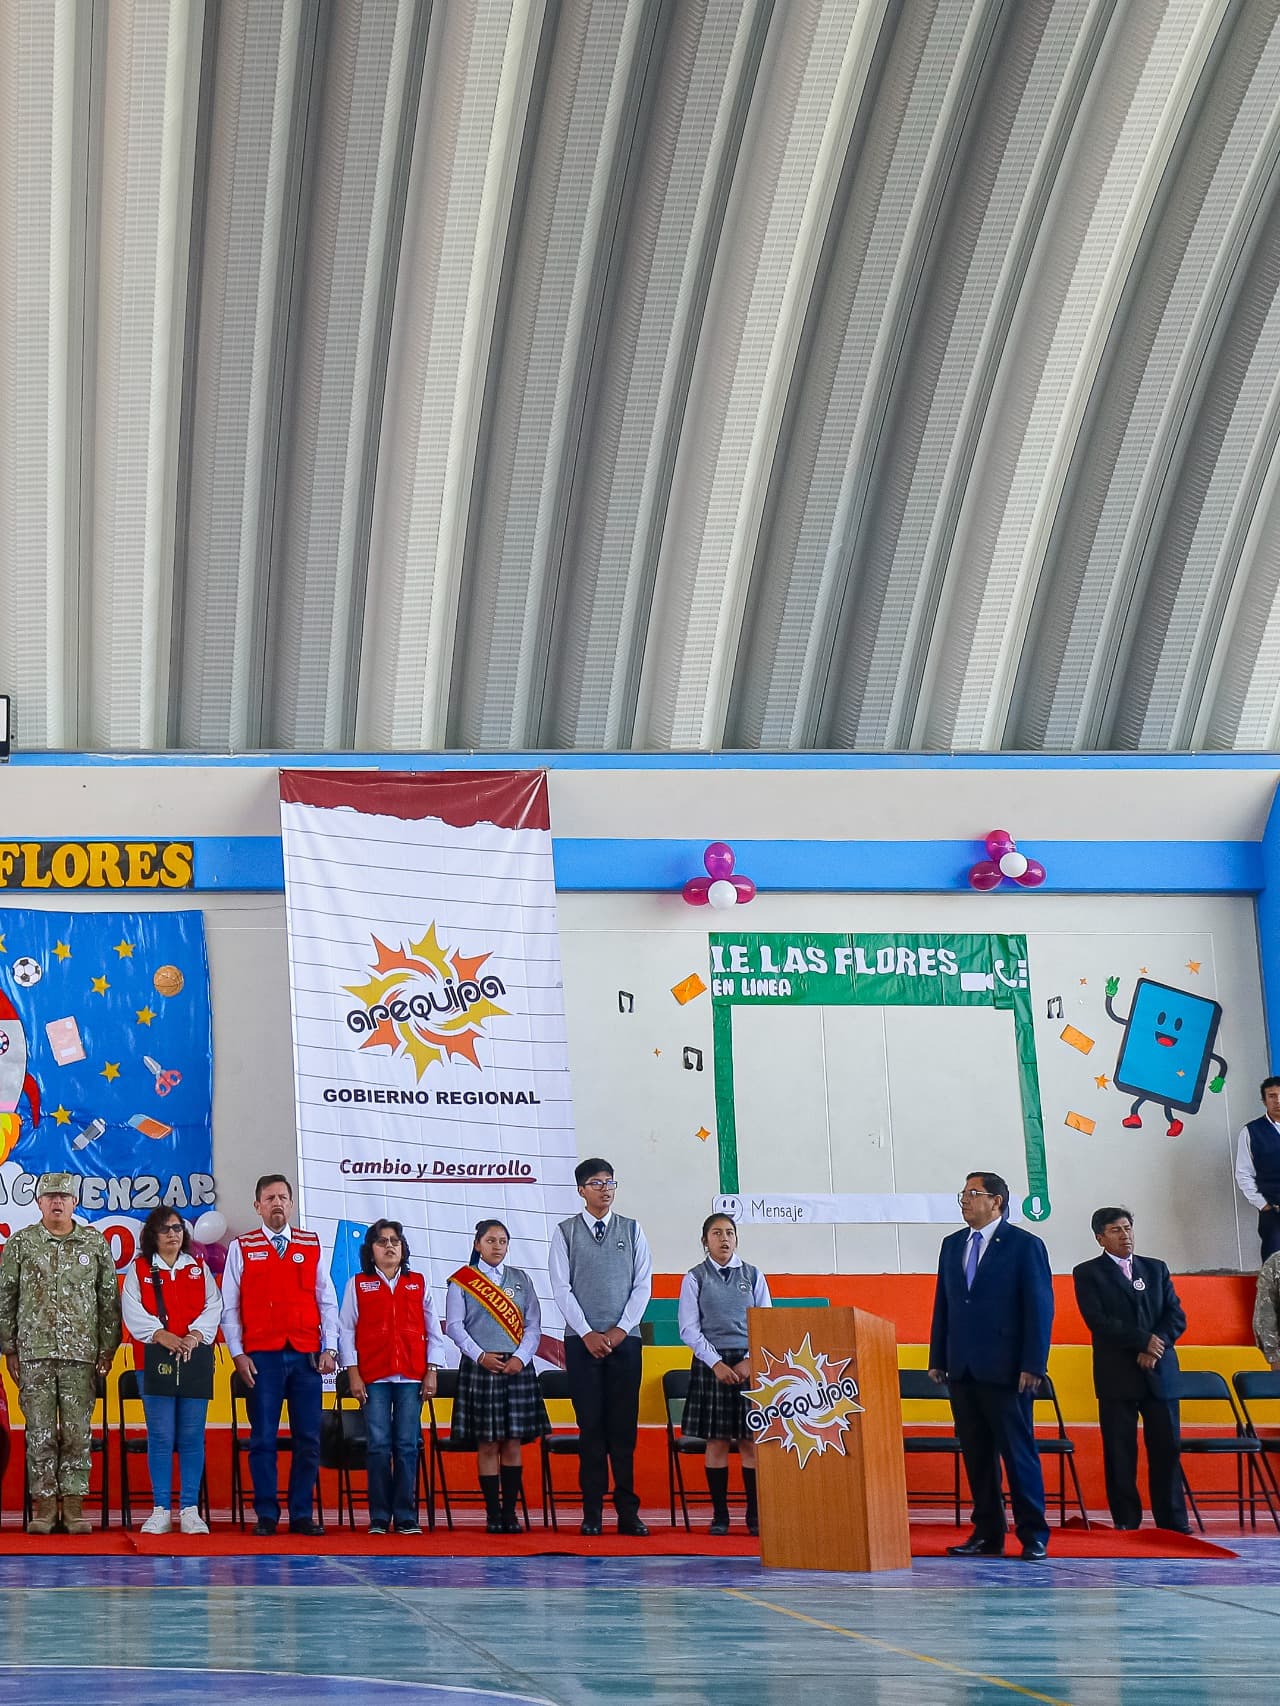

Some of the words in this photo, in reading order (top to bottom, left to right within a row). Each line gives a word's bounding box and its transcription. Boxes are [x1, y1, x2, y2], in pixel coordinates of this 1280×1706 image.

[711, 945, 755, 974] I.E.
[760, 945, 827, 974] LAS
[834, 947, 958, 976] FLORES
[712, 978, 734, 996] EN
[741, 978, 792, 996] LINEA
[323, 1088, 429, 1105] GOBIERNO
[436, 1090, 541, 1105] REGIONAL
[339, 1158, 412, 1175] Cambio
[416, 1163, 428, 1178] y
[432, 1159, 532, 1176] Desarrollo
[12, 1173, 216, 1211] CENZAR
[751, 1199, 804, 1222] Mensaje
[468, 1279, 520, 1332] ALCALDESA
